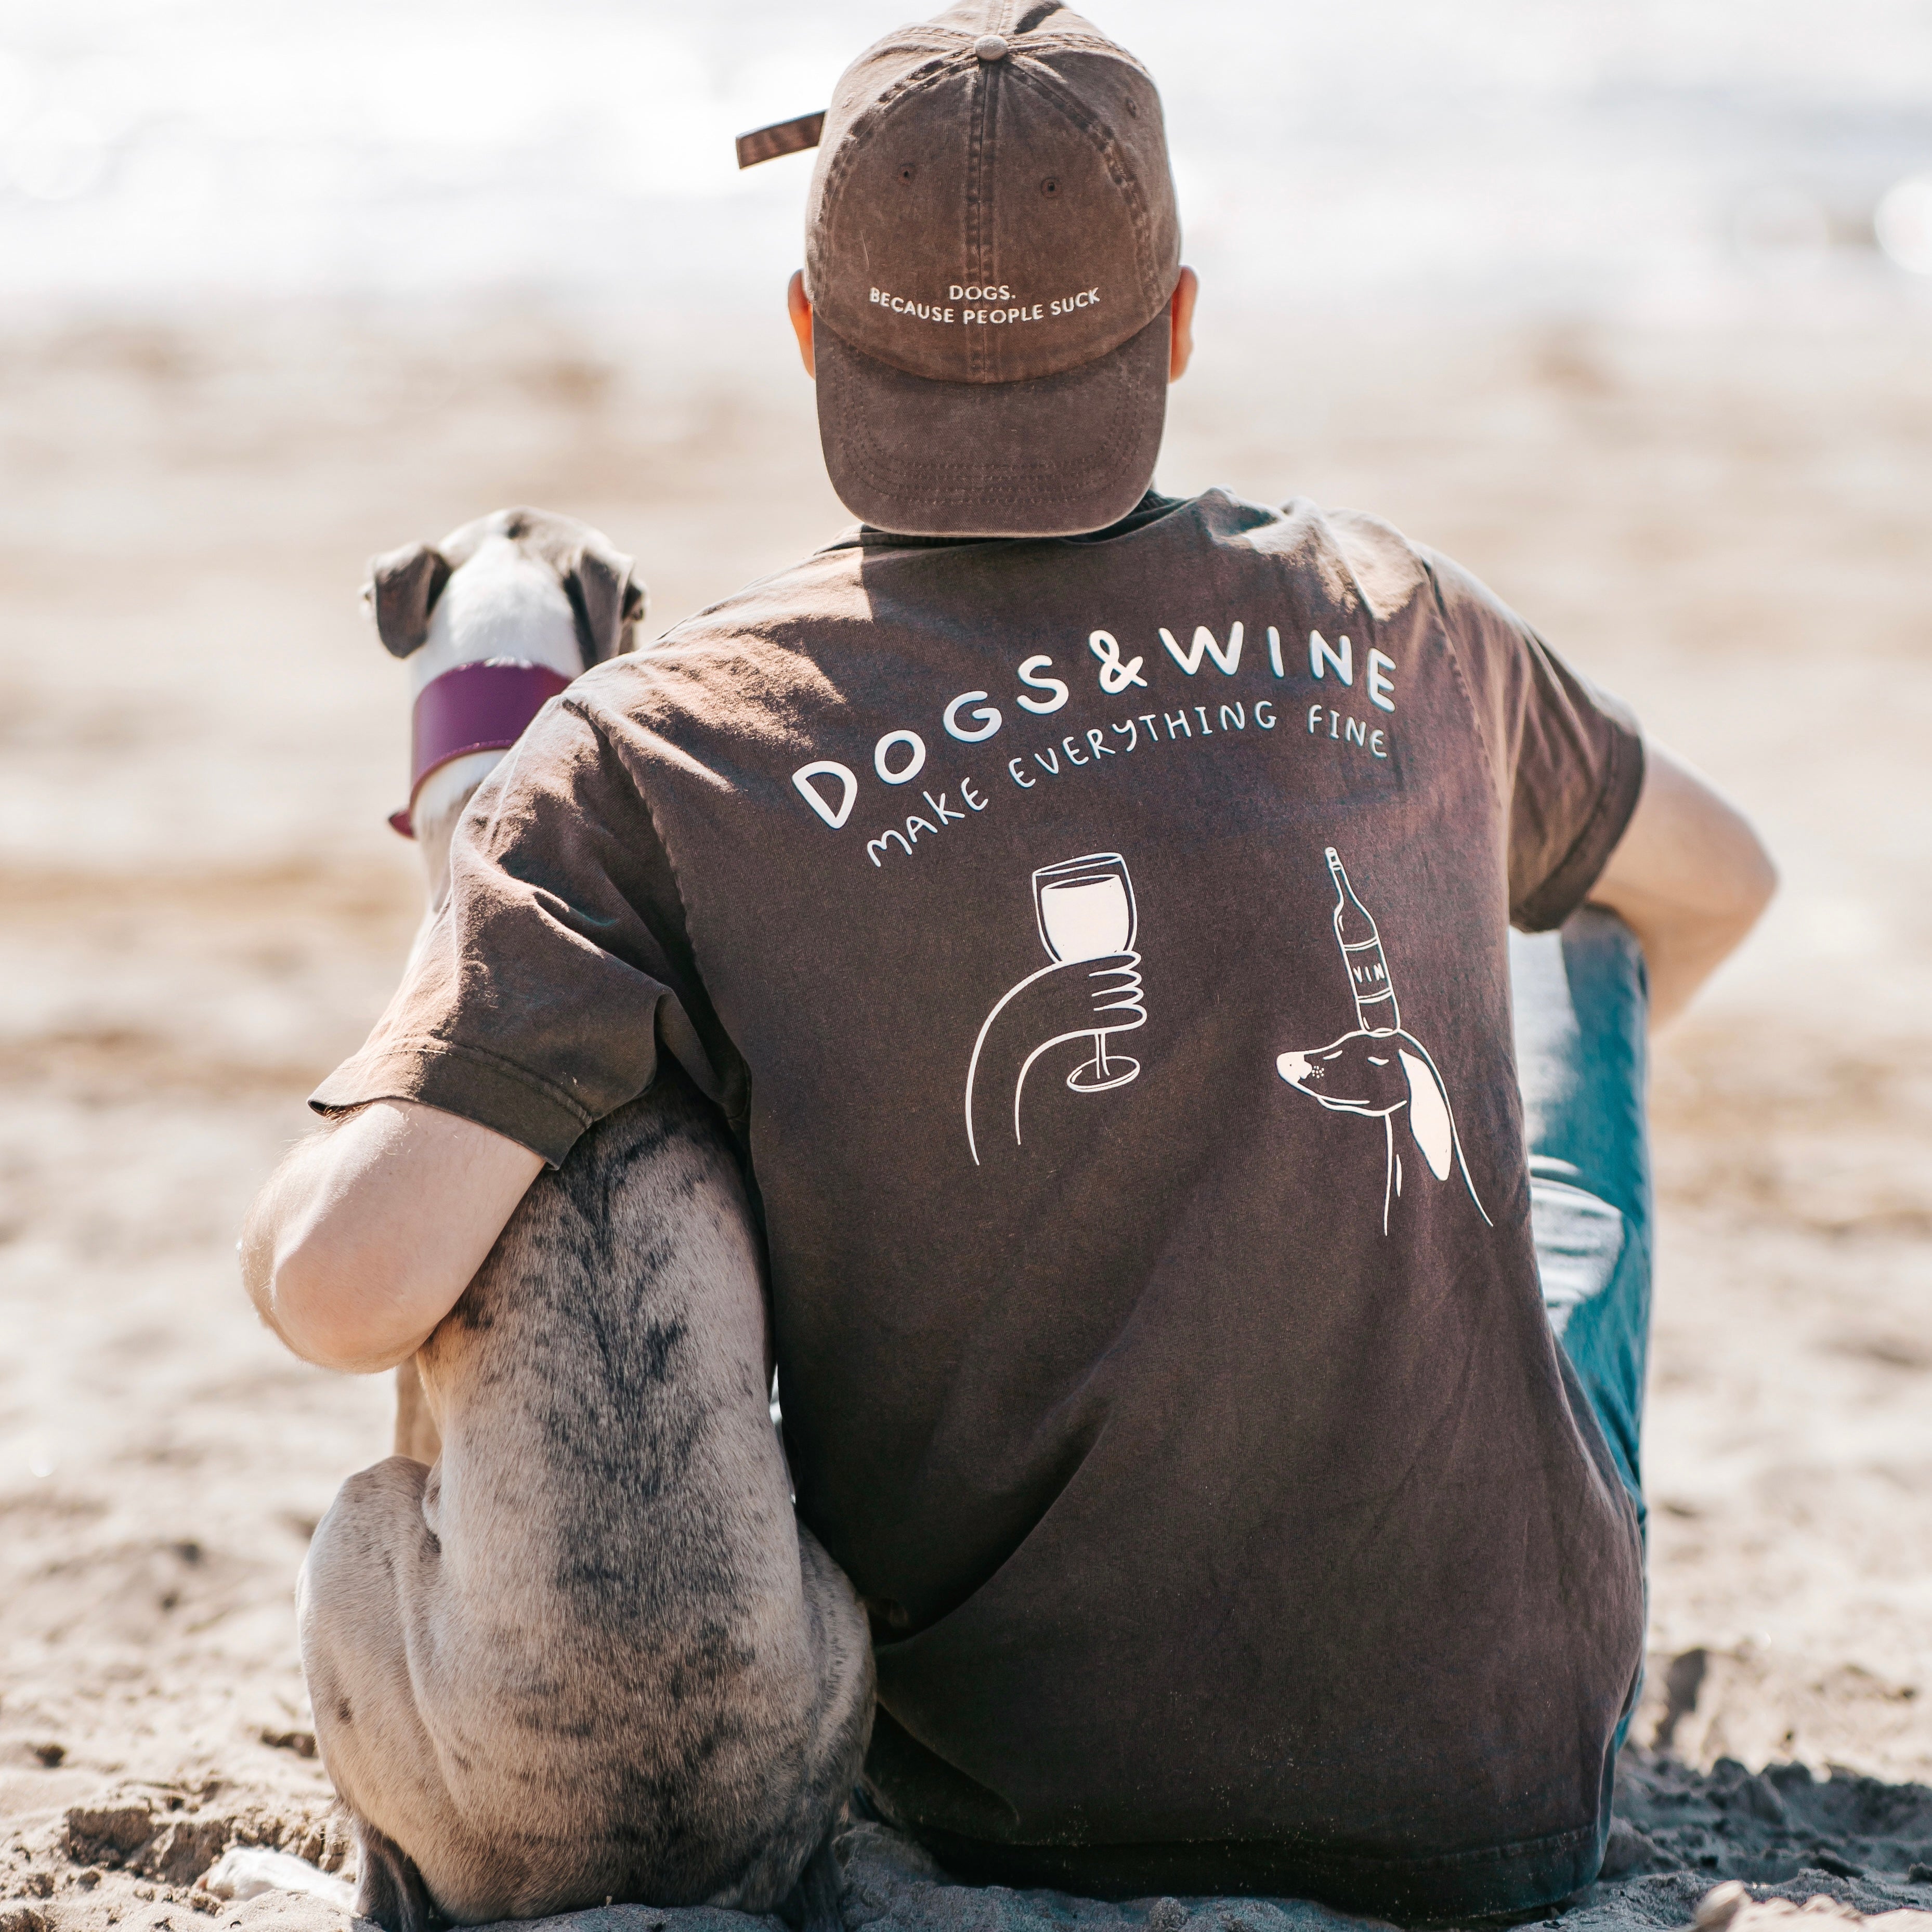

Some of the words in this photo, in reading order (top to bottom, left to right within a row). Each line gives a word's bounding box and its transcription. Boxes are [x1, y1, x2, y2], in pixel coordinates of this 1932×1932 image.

[869, 286, 955, 323] BECAUSE
[962, 304, 1043, 325] PEOPLE
[1050, 286, 1101, 316] SUCK
[949, 285, 1016, 301] DOGS.
[791, 654, 1069, 828] DOGS
[1158, 621, 1396, 712] WINE
[867, 776, 989, 867] MAKE
[1008, 700, 1277, 788] EVERYTHING
[1308, 704, 1388, 759] FINE
[1353, 962, 1385, 983] VIN
